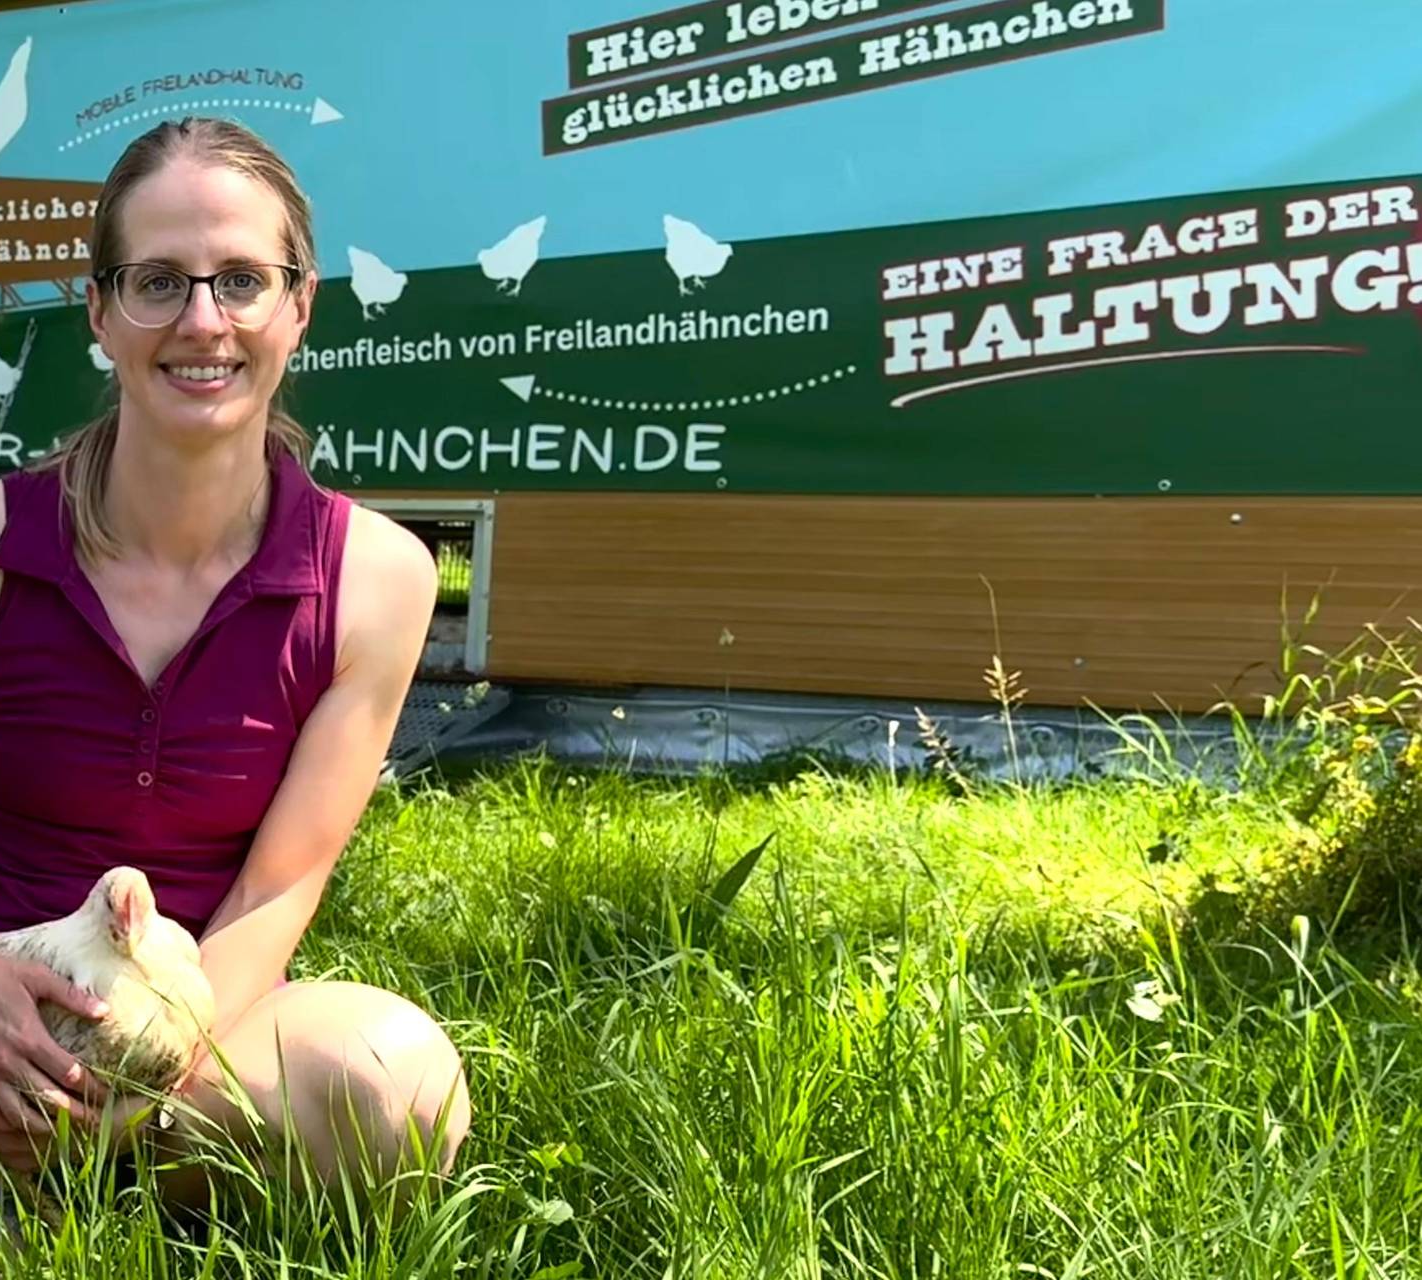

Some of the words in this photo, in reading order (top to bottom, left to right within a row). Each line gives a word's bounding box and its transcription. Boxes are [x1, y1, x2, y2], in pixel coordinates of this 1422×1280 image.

[562, 56, 838, 145] glücklichen
[858, 0, 1134, 76] Hähnchen
[586, 26, 705, 76] Hier
[75, 85, 137, 127] MOBILE
[141, 67, 304, 91] FREILANDHALTUNG
[882, 245, 1024, 301] EINE
[1047, 208, 1259, 277] FRAGE
[1284, 185, 1419, 239] DER
[287, 333, 452, 373] chenfleisch
[458, 332, 517, 360] von
[524, 303, 830, 354] Freilandhähnchen
[882, 242, 1422, 376] HALTUNG!
[309, 423, 727, 473] ÄHNCHEN.DE
